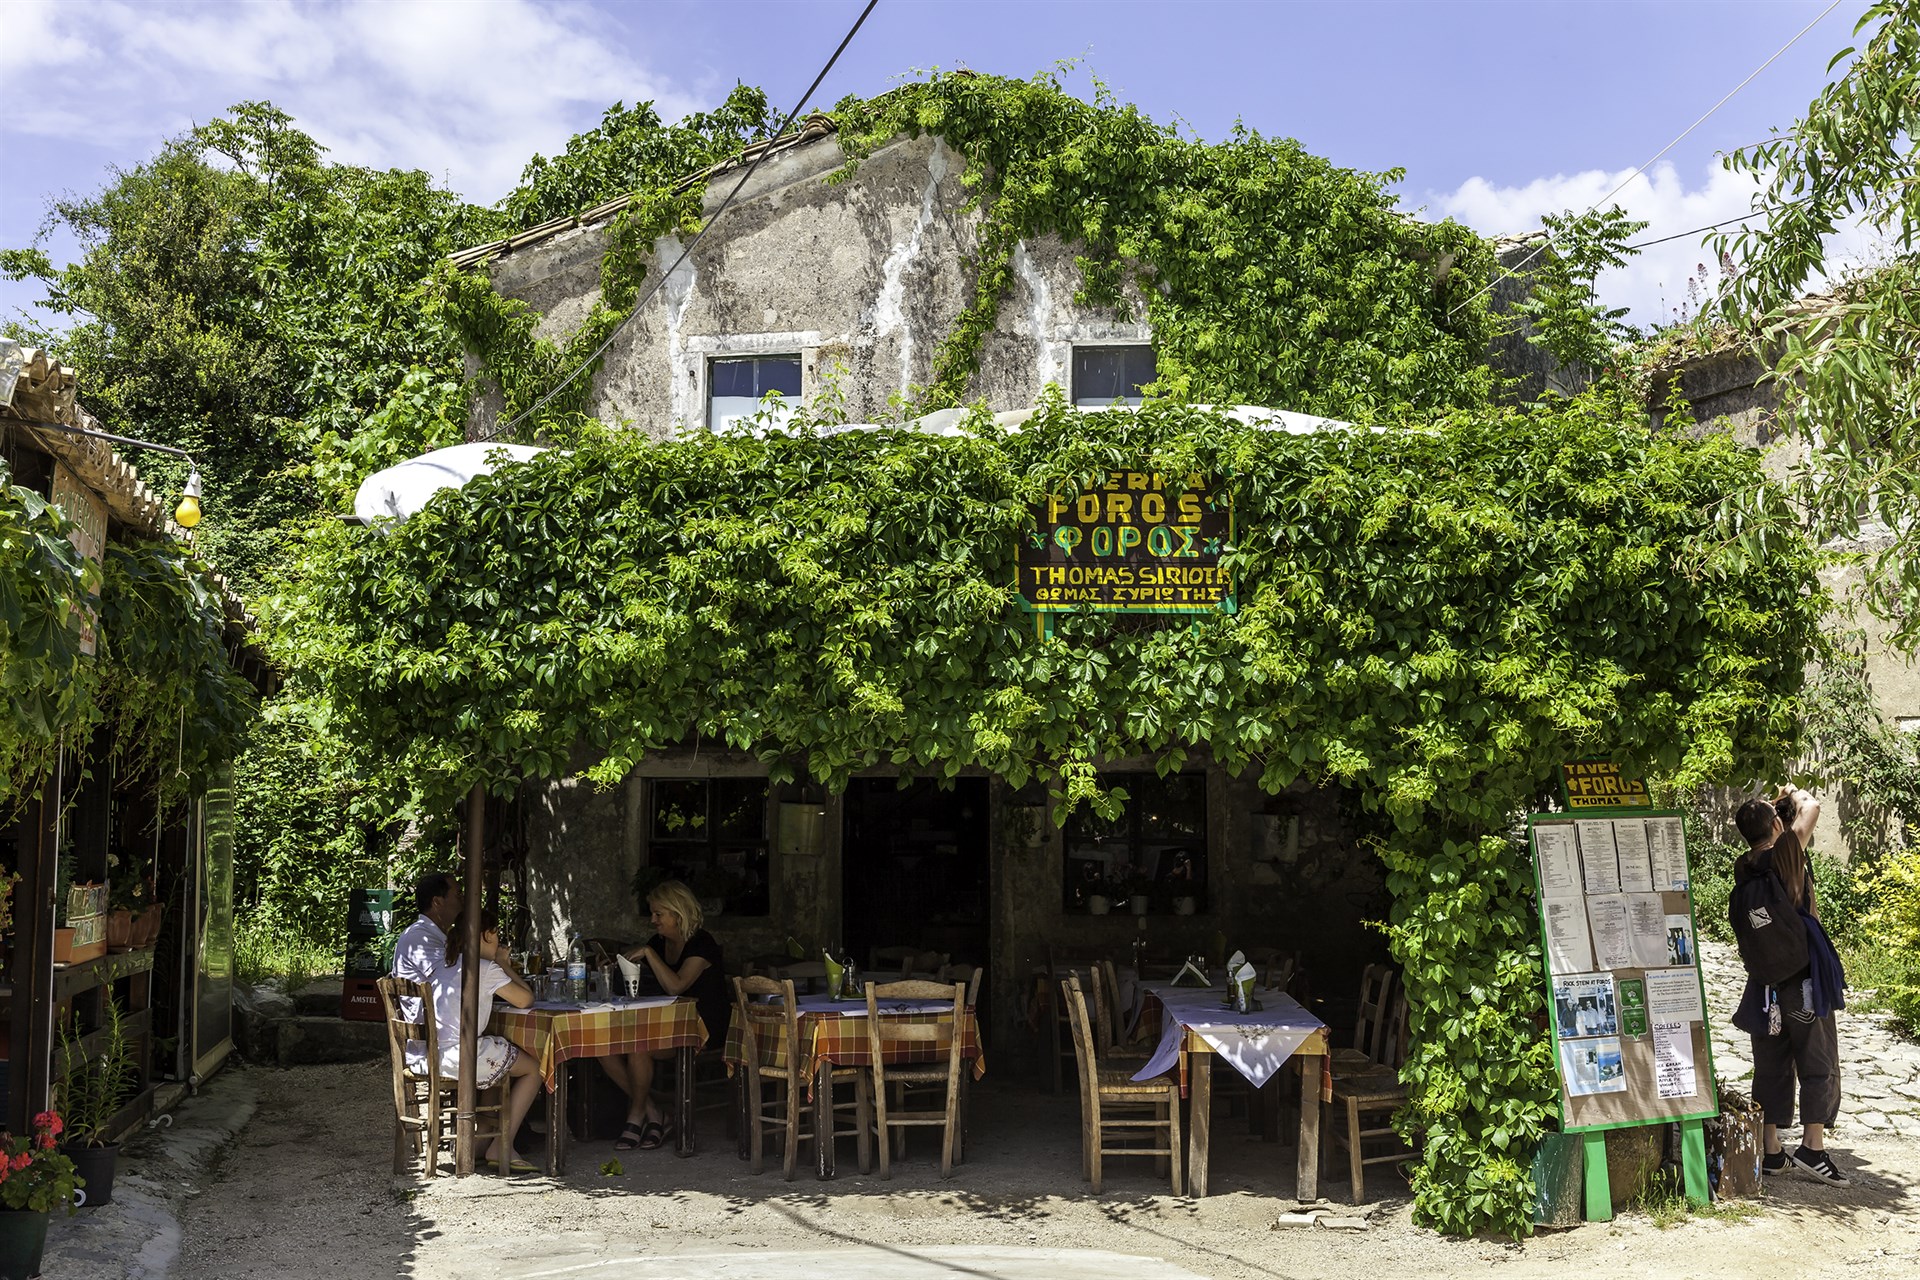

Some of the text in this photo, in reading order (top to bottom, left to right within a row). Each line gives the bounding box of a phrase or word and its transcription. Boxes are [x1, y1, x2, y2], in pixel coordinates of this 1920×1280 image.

[1047, 493, 1203, 524] FOROS
[1054, 525, 1202, 559] ΦΟΡΟΣ
[1029, 566, 1135, 585] THOMAS
[1578, 776, 1644, 795] FOROS
[1572, 796, 1622, 805] THOMAS
[350, 995, 378, 1004] AMSTEL
